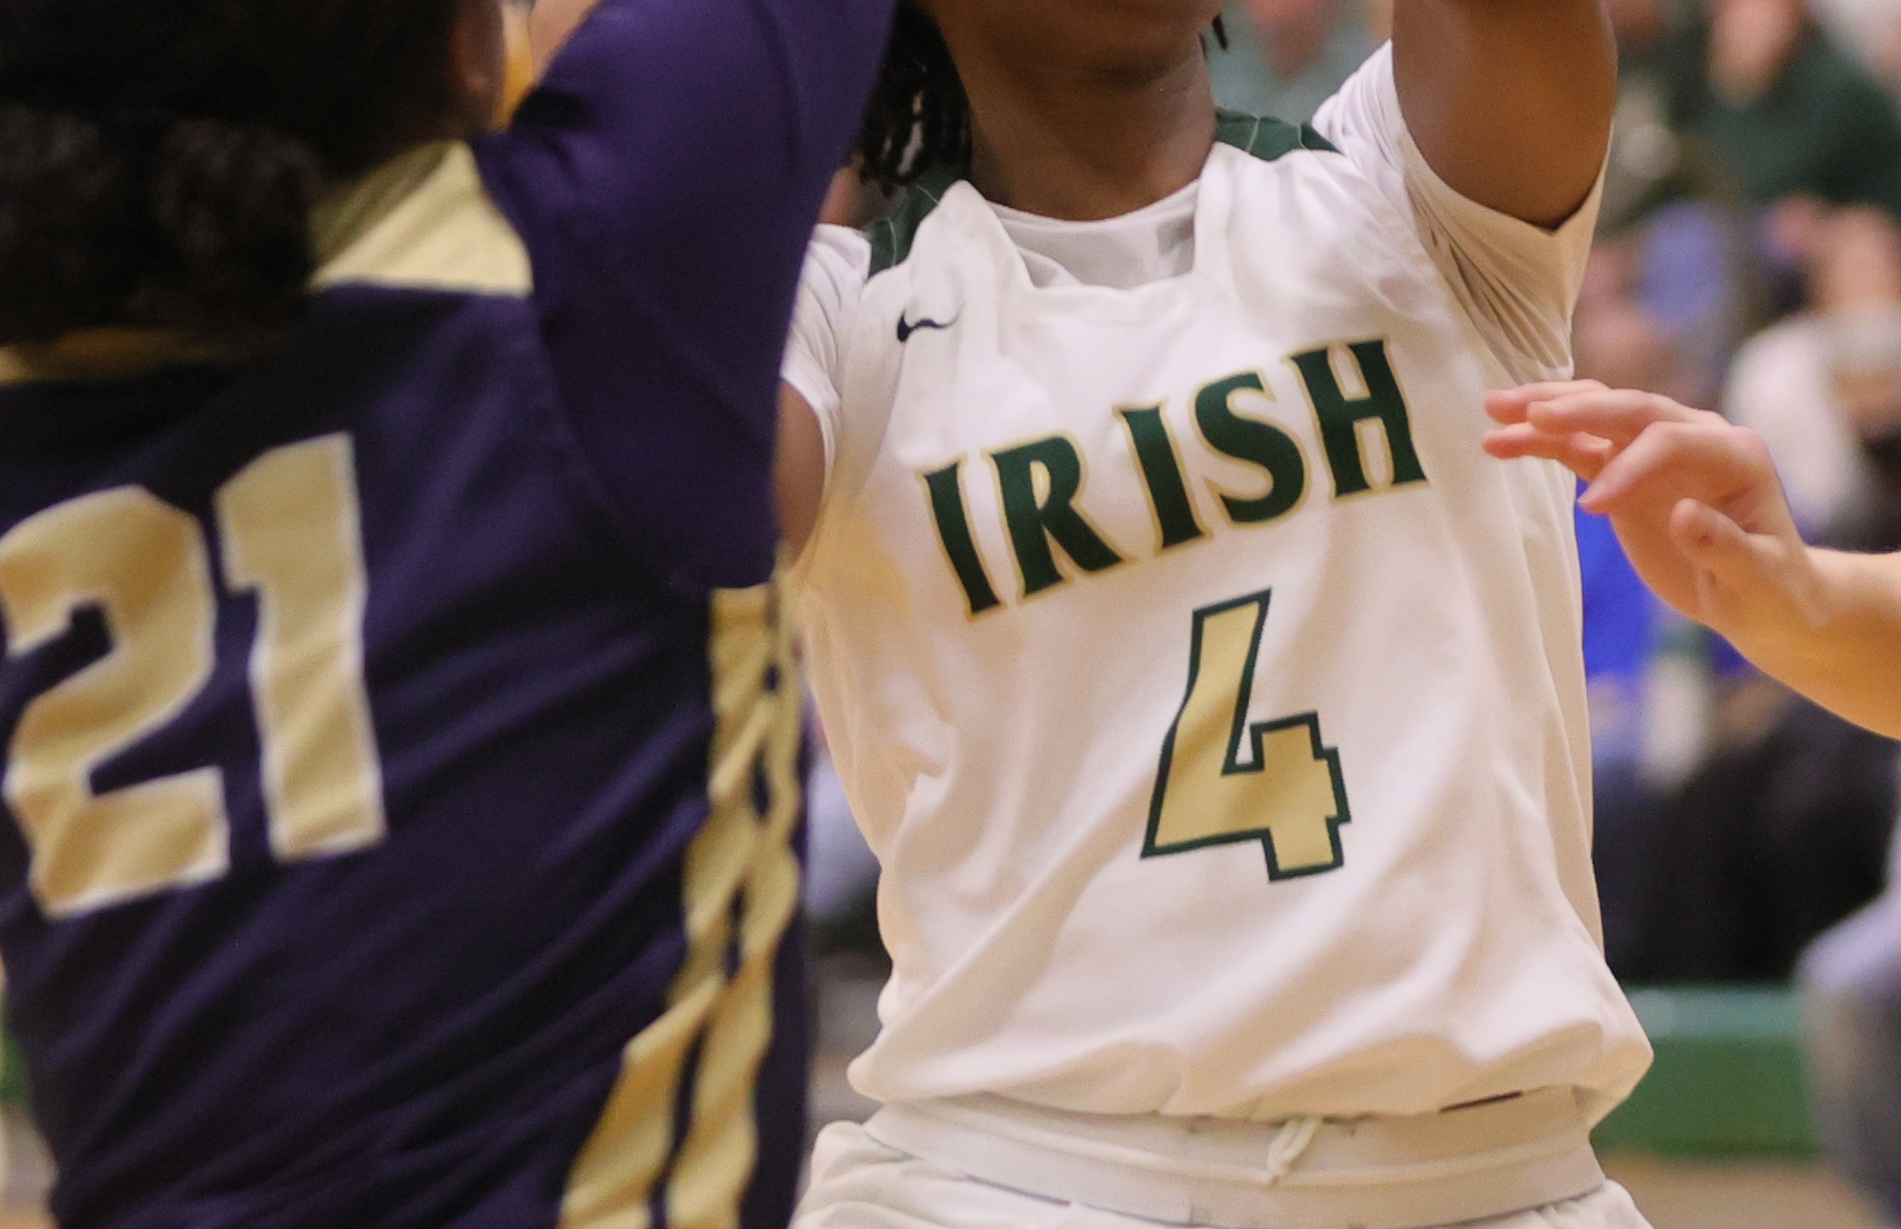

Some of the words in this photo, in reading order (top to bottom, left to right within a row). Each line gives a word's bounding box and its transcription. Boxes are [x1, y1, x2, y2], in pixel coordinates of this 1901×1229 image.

[914, 337, 1428, 620] IRISH
[0, 429, 388, 919] 21
[1140, 586, 1352, 883] 4
